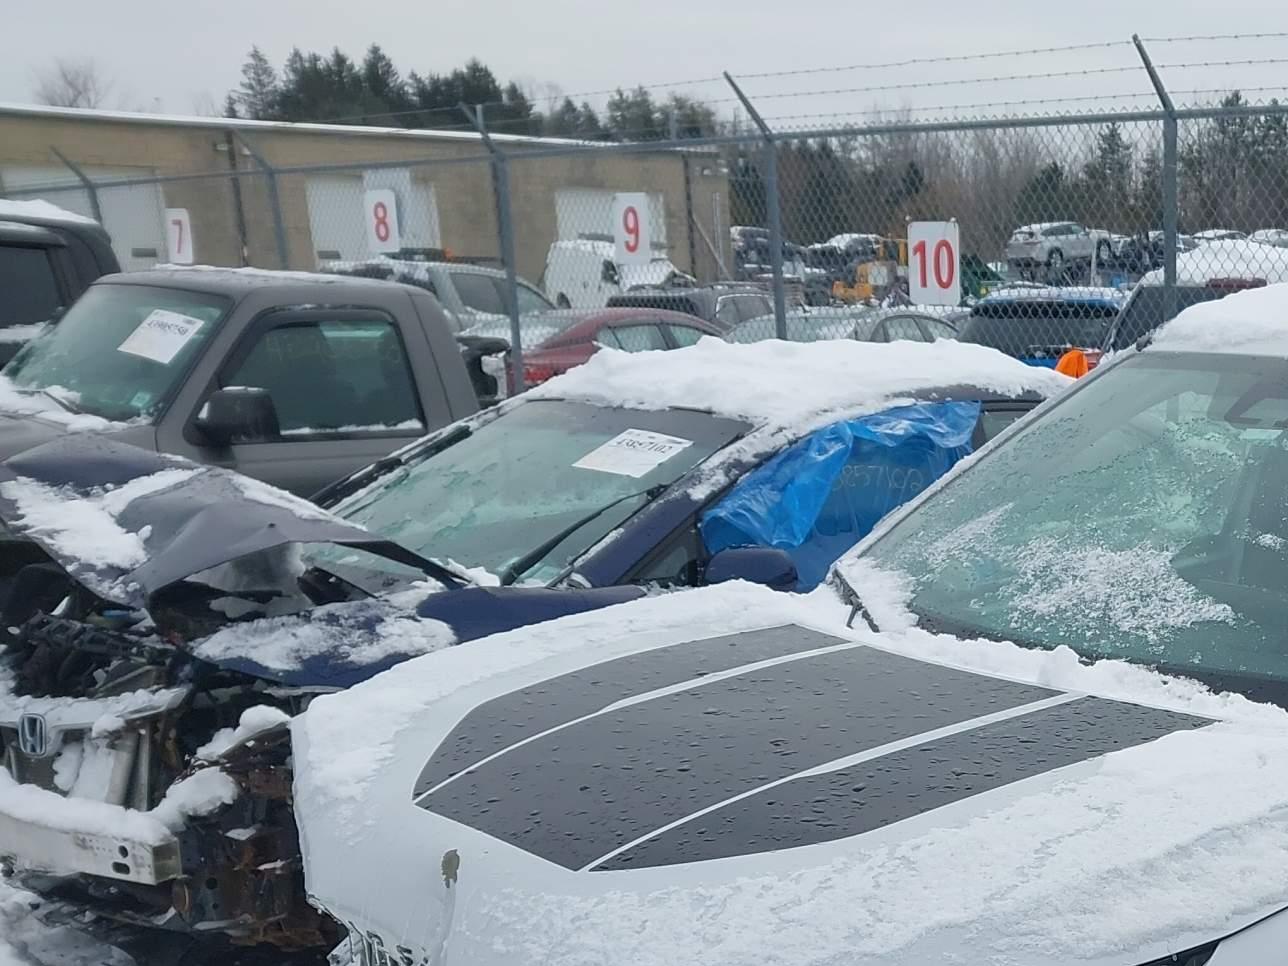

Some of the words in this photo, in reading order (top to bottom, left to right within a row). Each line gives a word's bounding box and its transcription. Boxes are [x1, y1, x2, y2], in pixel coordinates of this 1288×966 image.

[171, 219, 183, 254] 7
[373, 201, 390, 242] 8
[623, 206, 639, 253] 9
[912, 240, 954, 289] 10
